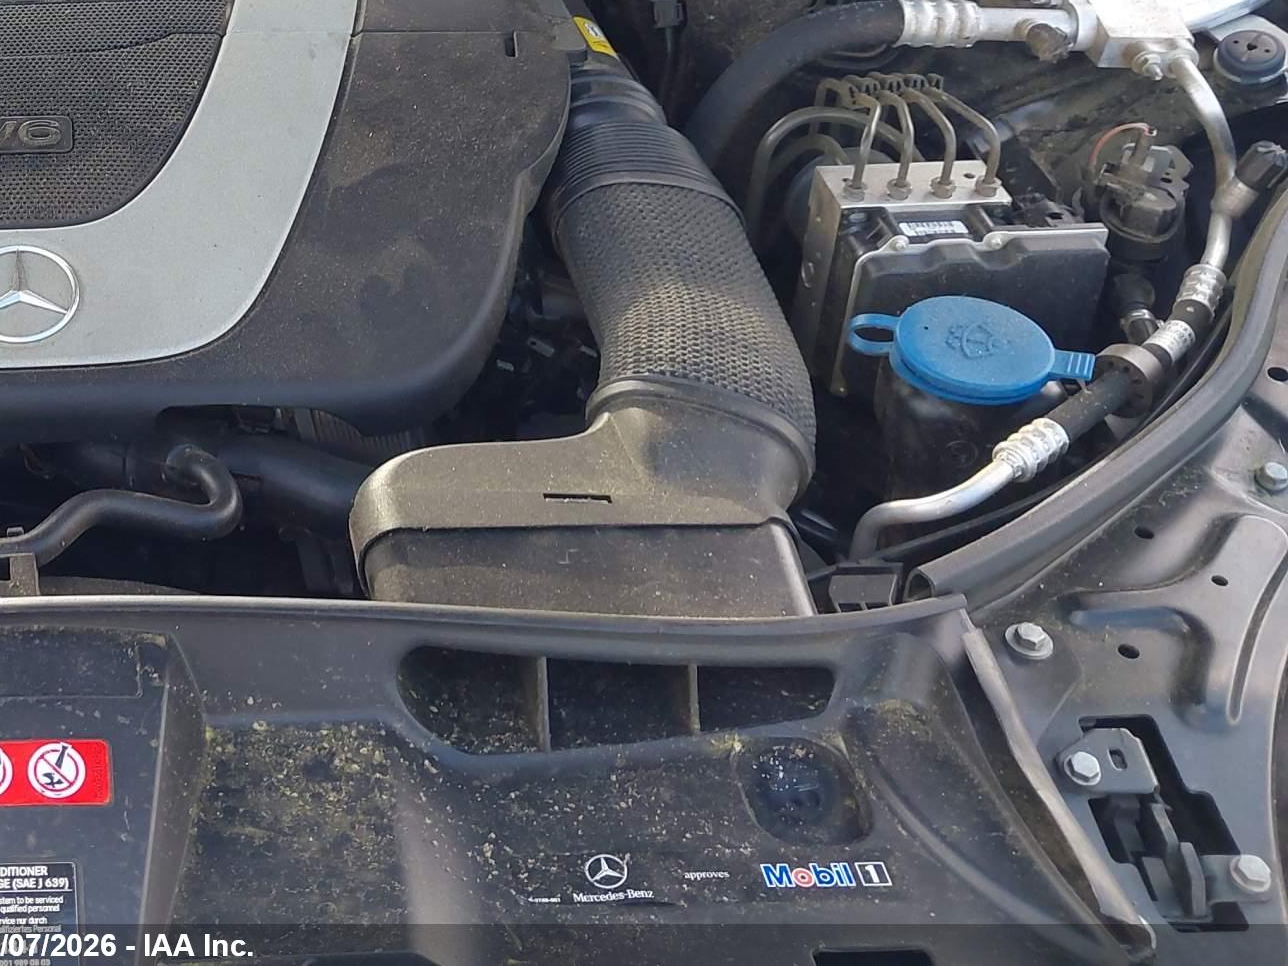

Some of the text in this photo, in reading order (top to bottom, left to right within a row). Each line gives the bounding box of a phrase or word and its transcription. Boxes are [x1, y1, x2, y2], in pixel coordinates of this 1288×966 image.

[683, 870, 730, 882] approves
[760, 862, 857, 888] Mobil
[12, 878, 37, 890] (SAE
[37, 877, 43, 889] J
[44, 877, 69, 890] 639)
[16, 897, 25, 905] to
[25, 897, 34, 905] be
[35, 896, 64, 904] serviced
[572, 888, 655, 903] Mercedes-Benz
[1, 904, 27, 914] qualified
[29, 916, 48, 925] durch
[33, 925, 62, 933] Personal
